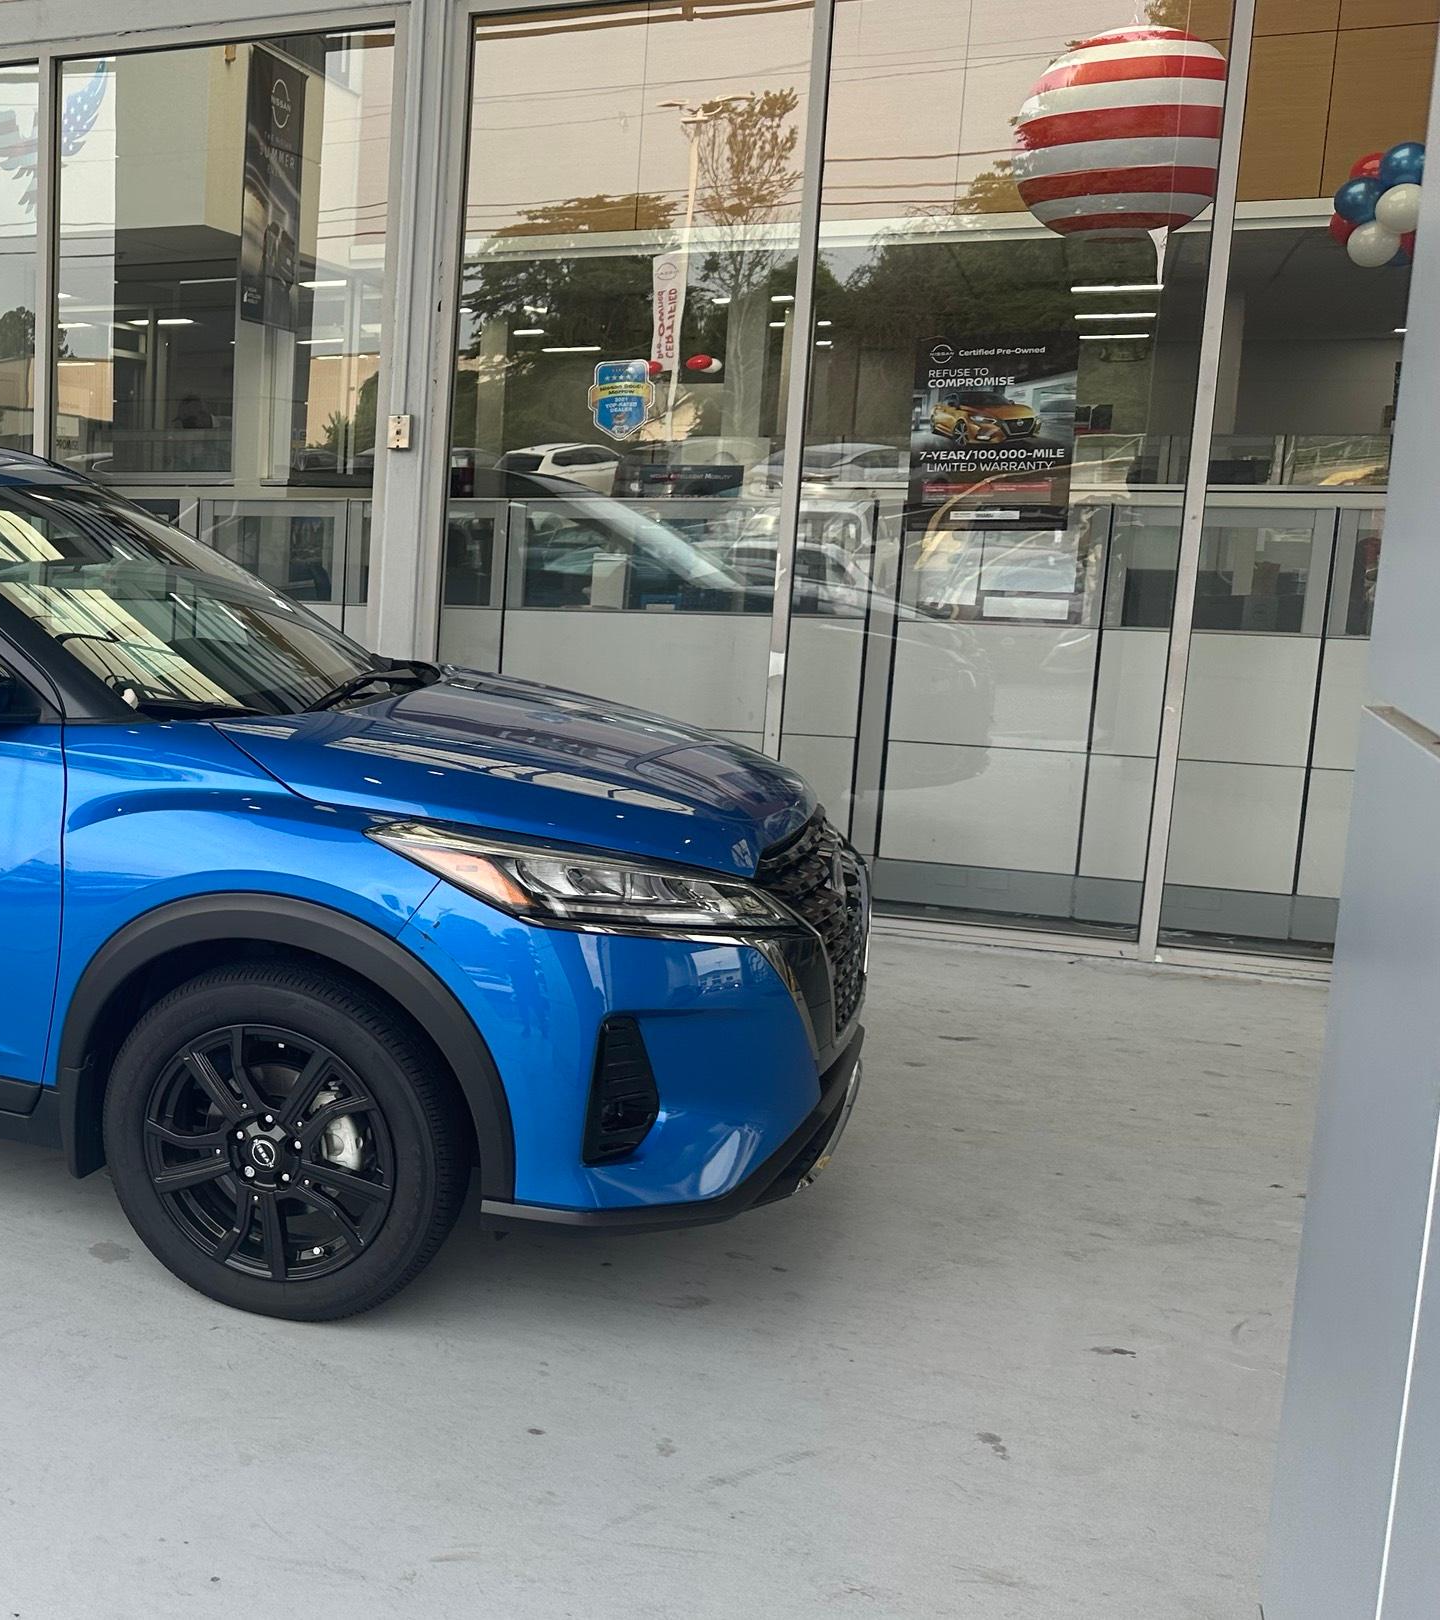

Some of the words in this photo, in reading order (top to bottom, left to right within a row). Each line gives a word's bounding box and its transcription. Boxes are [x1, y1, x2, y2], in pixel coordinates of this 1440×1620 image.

[271, 94, 292, 112] NISSAN
[958, 348, 995, 357] Certified
[996, 346, 1046, 355] Pre-Owned
[928, 368, 971, 378] REFUSE
[973, 367, 989, 376] TO
[927, 376, 1015, 388] COMPROMISE
[920, 449, 1064, 460] 7-YEAR/100,000-MILE
[926, 462, 977, 473] LIMITED
[253, 1139, 274, 1168] NISSAN
